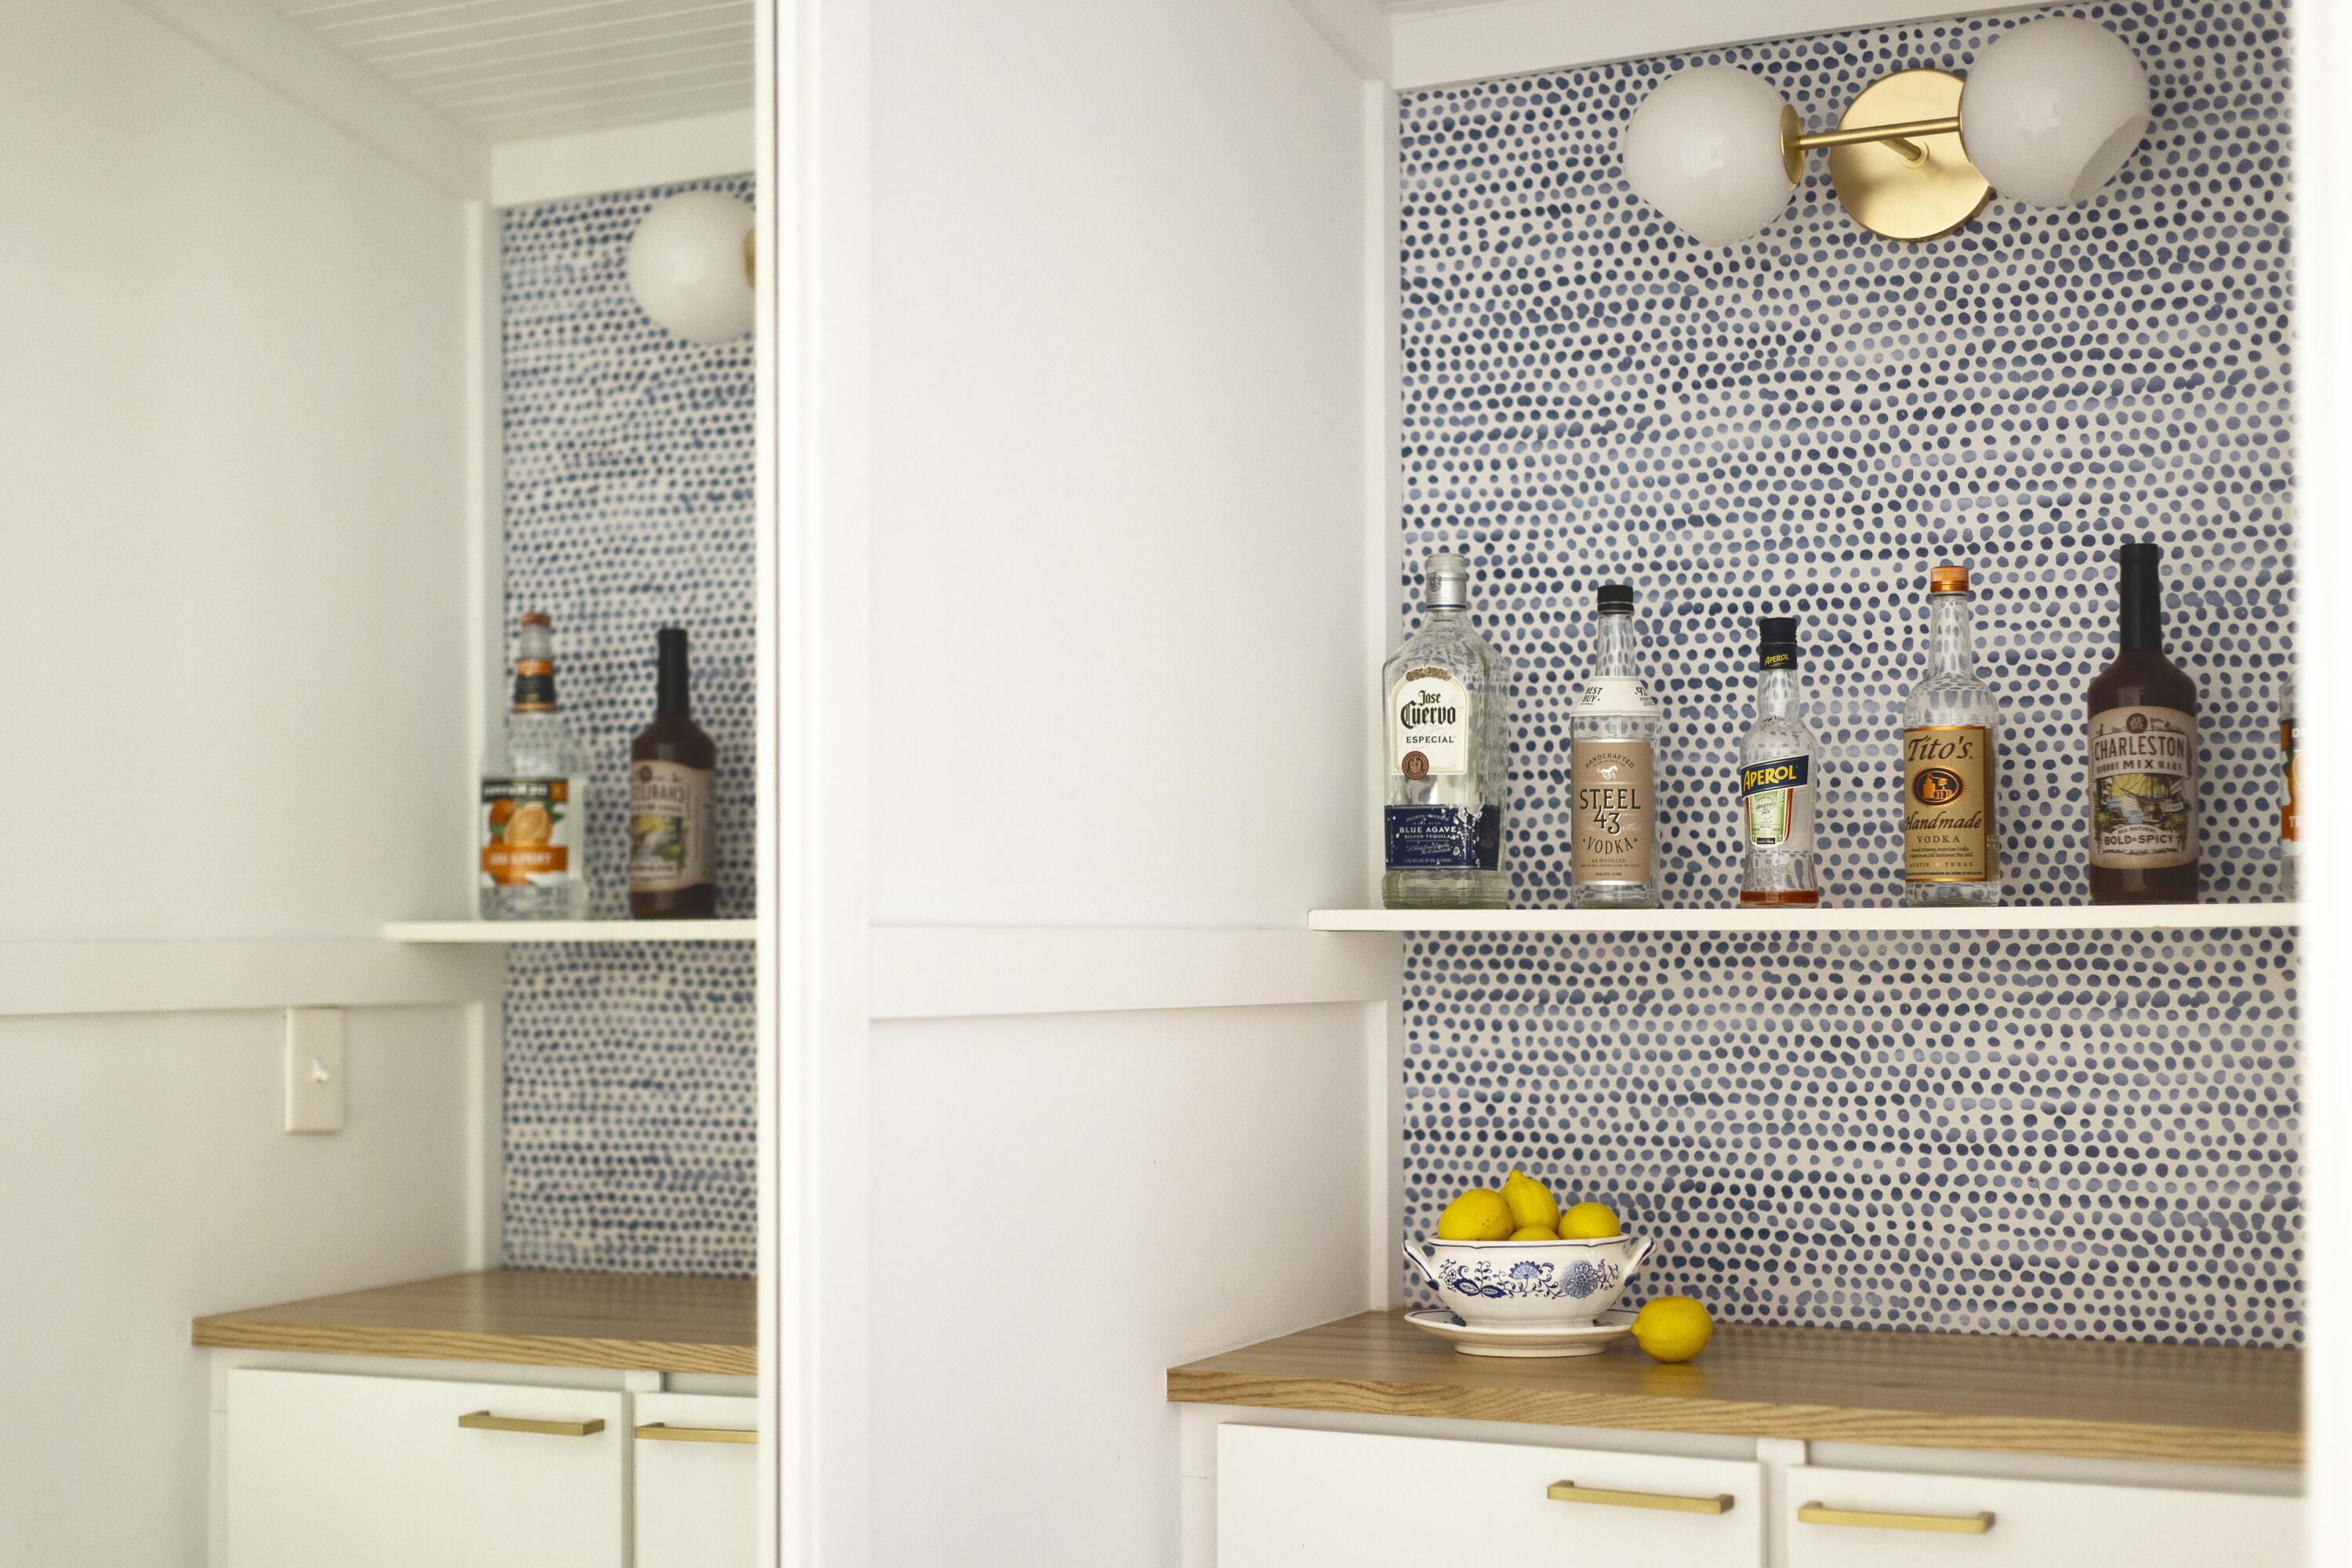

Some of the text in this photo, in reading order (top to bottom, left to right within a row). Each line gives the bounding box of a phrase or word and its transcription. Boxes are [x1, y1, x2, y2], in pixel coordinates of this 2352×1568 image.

[1765, 653, 1789, 666] APEROL
[1418, 690, 1441, 706] Jose
[1400, 700, 1456, 730] Cuervo
[1907, 735, 1973, 761] Tito's
[2094, 735, 2184, 760] CHARLESTON
[1585, 753, 1634, 769] HANDCRAFTED
[2123, 759, 2154, 769] MIX
[1744, 764, 1797, 792] APEROL
[1580, 789, 1641, 810] STEEL
[1593, 805, 1621, 835] 43
[1905, 811, 1983, 831] Handmade
[1587, 836, 1634, 855] VODKA
[1917, 835, 1961, 844] VODKA
[2104, 836, 2132, 845] BOLD
[2139, 834, 2174, 844] SPICY
